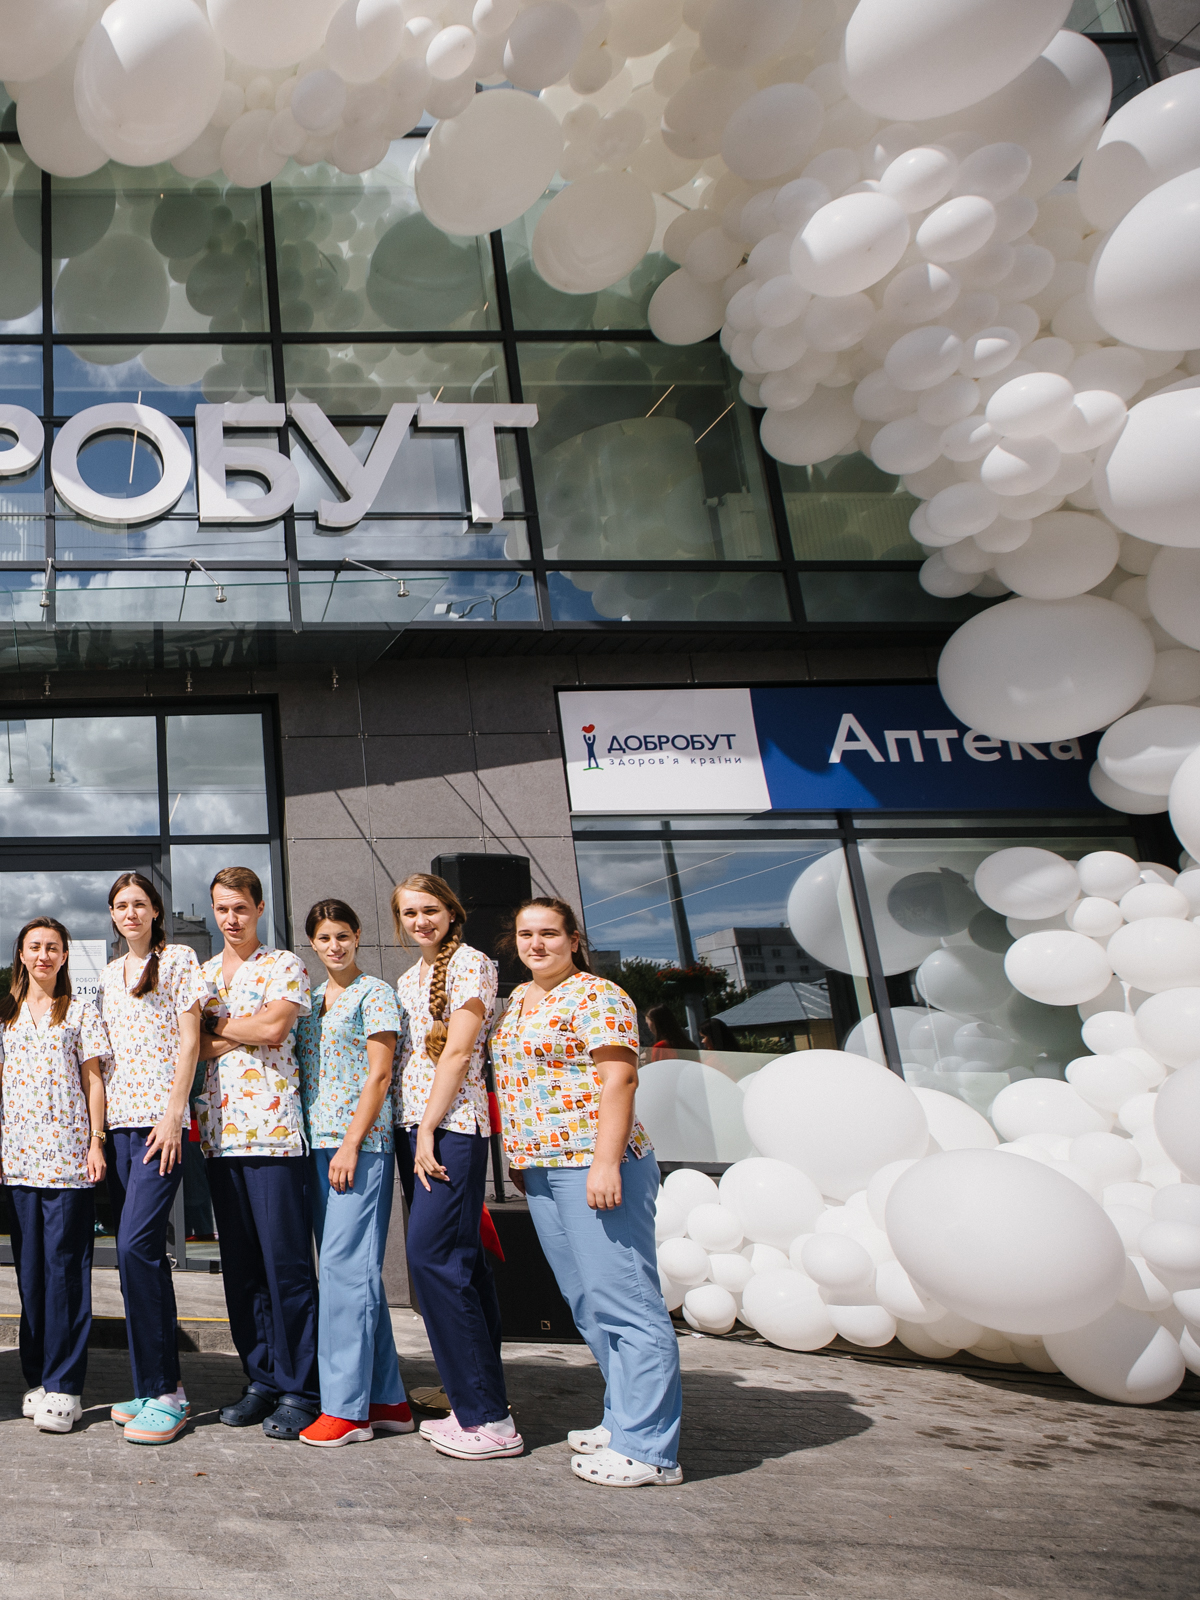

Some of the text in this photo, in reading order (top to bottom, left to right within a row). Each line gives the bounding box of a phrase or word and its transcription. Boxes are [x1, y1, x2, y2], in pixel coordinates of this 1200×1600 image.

[607, 734, 737, 754] ДОБРОБУТ
[690, 755, 742, 767] країни
[76, 986, 100, 995] 21:0
